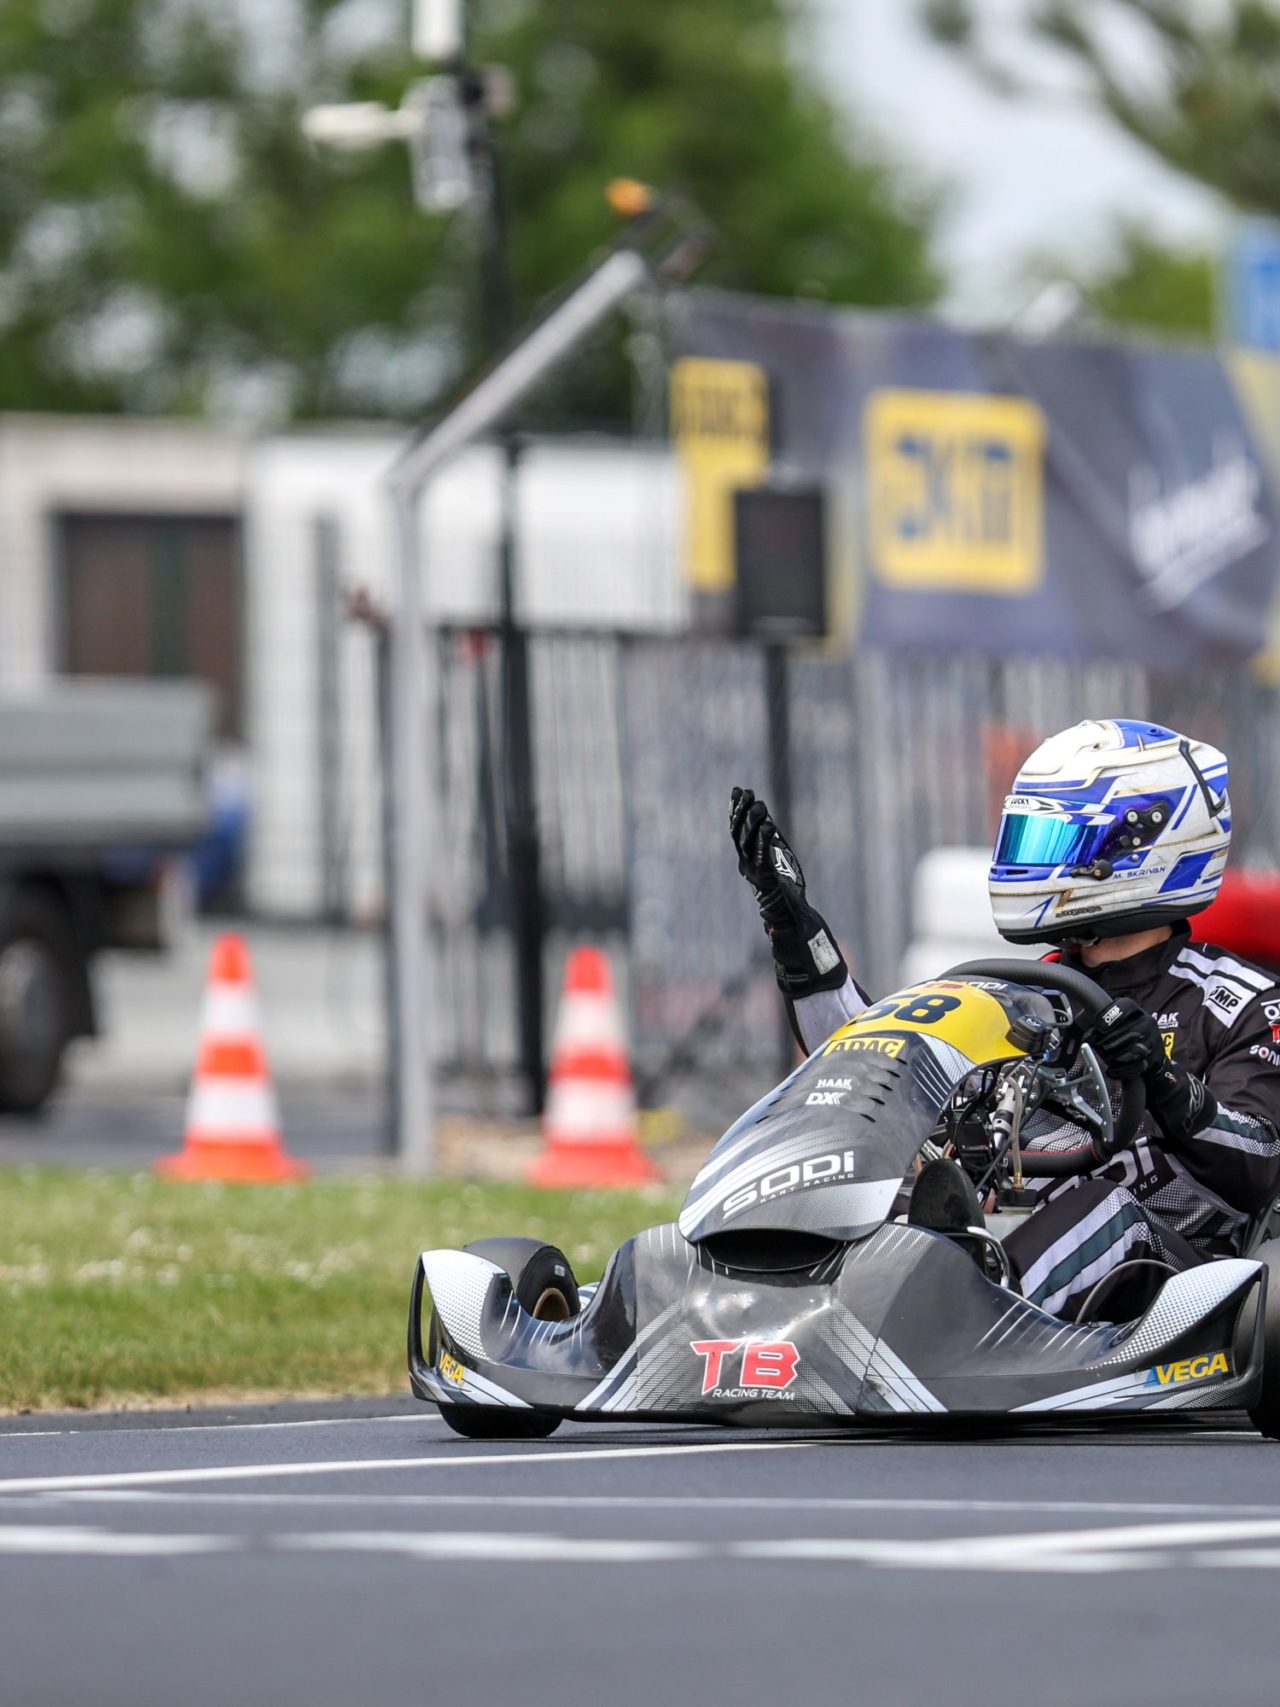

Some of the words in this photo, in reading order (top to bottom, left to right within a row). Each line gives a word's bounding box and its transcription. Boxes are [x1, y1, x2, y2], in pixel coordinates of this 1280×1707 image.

[856, 993, 962, 1024] 58
[1104, 1005, 1121, 1024] OMP
[830, 1040, 899, 1055] ADAC
[815, 1079, 852, 1091] HAAK
[722, 1150, 855, 1219] SODI
[760, 1186, 796, 1203] KART
[803, 1173, 855, 1188] RACING
[439, 1350, 465, 1382] VEGA
[689, 1338, 801, 1396] TB
[1156, 1353, 1229, 1385] VEGA
[712, 1388, 759, 1398] RACING
[760, 1389, 796, 1401] TEAM
